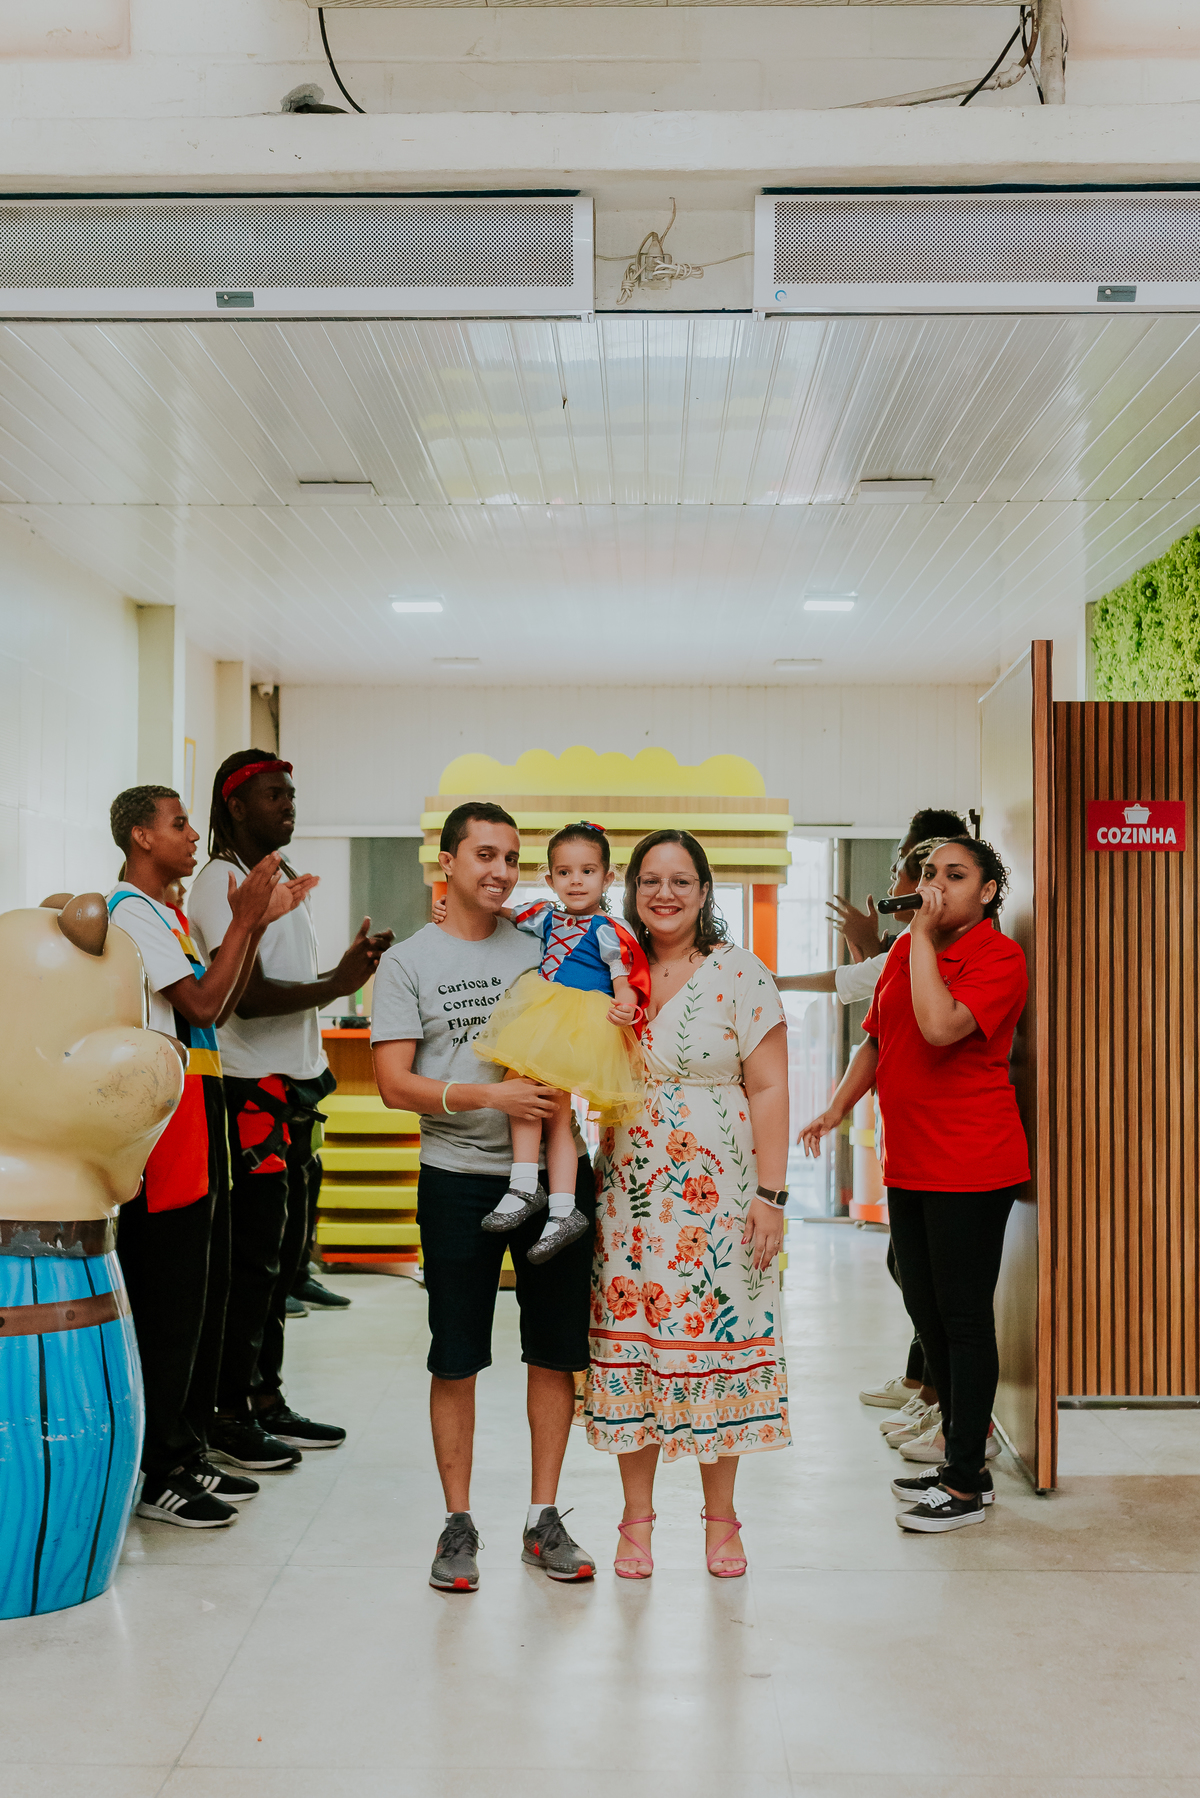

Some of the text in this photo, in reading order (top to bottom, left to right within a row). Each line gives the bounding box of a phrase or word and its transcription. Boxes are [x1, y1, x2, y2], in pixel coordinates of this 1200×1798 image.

[1096, 827, 1177, 844] COZINHA
[438, 976, 502, 995] Carioca &
[443, 993, 501, 1012] Corredor
